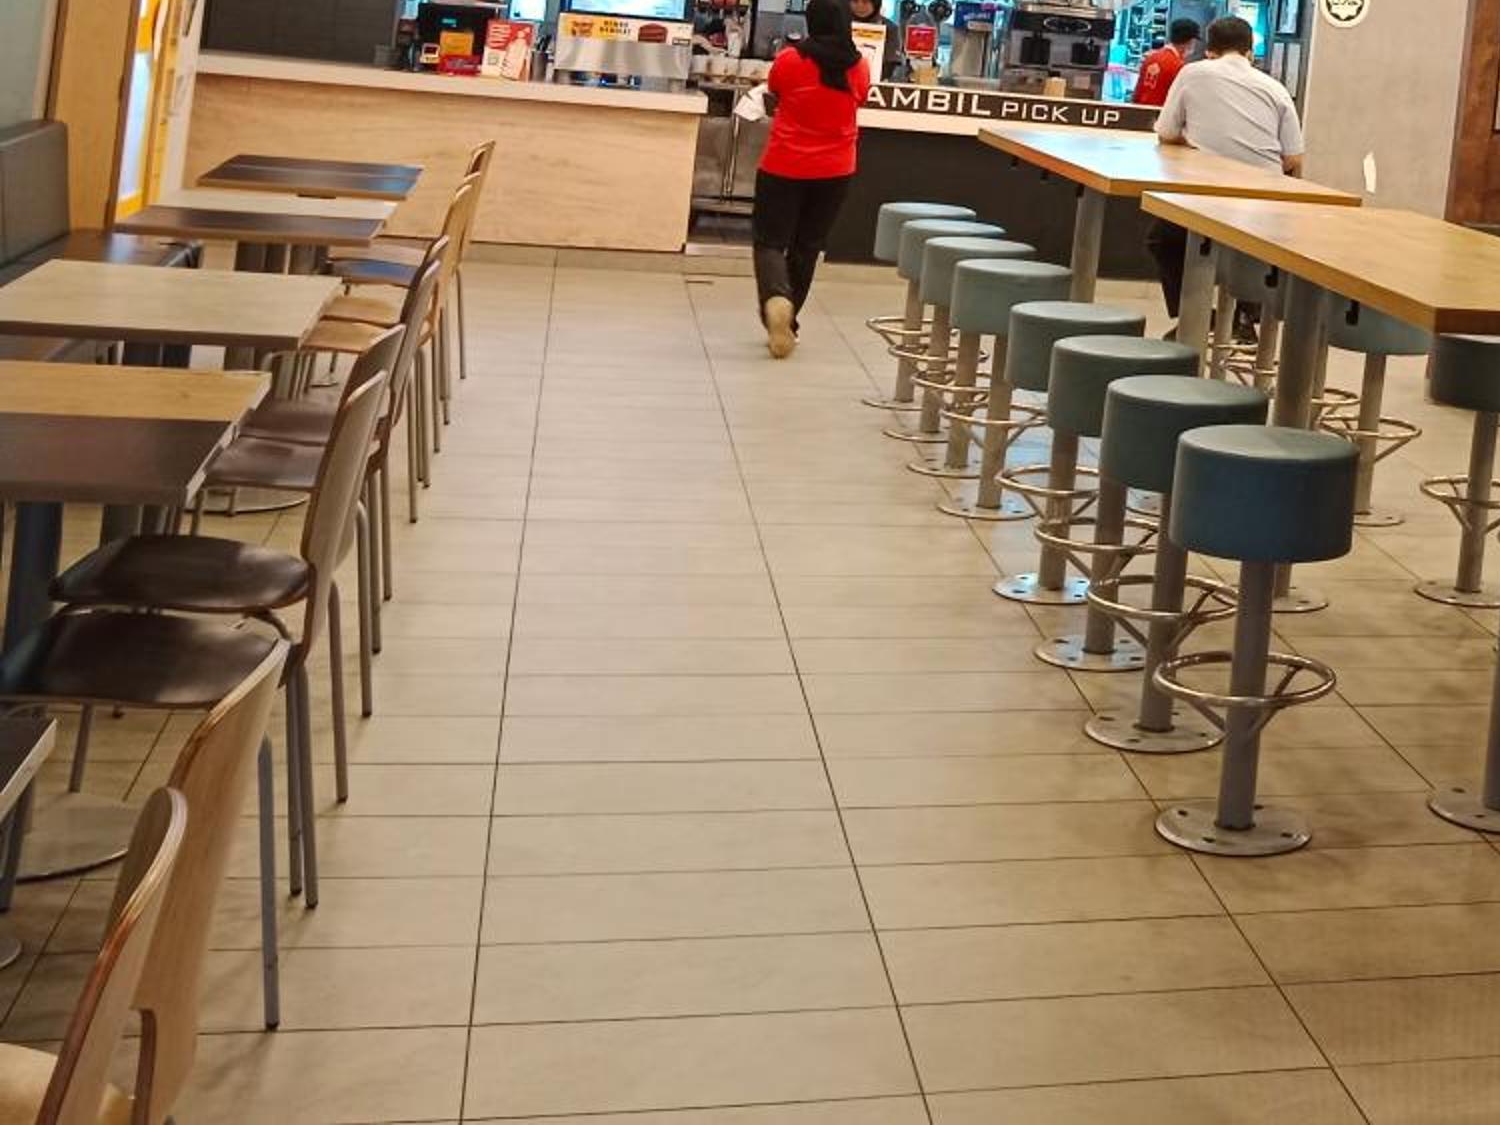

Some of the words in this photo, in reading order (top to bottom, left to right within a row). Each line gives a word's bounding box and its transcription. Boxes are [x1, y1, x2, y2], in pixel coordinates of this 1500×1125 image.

[865, 85, 992, 117] AMBIL
[1001, 100, 1070, 124] PICK
[1081, 107, 1121, 127] UP
